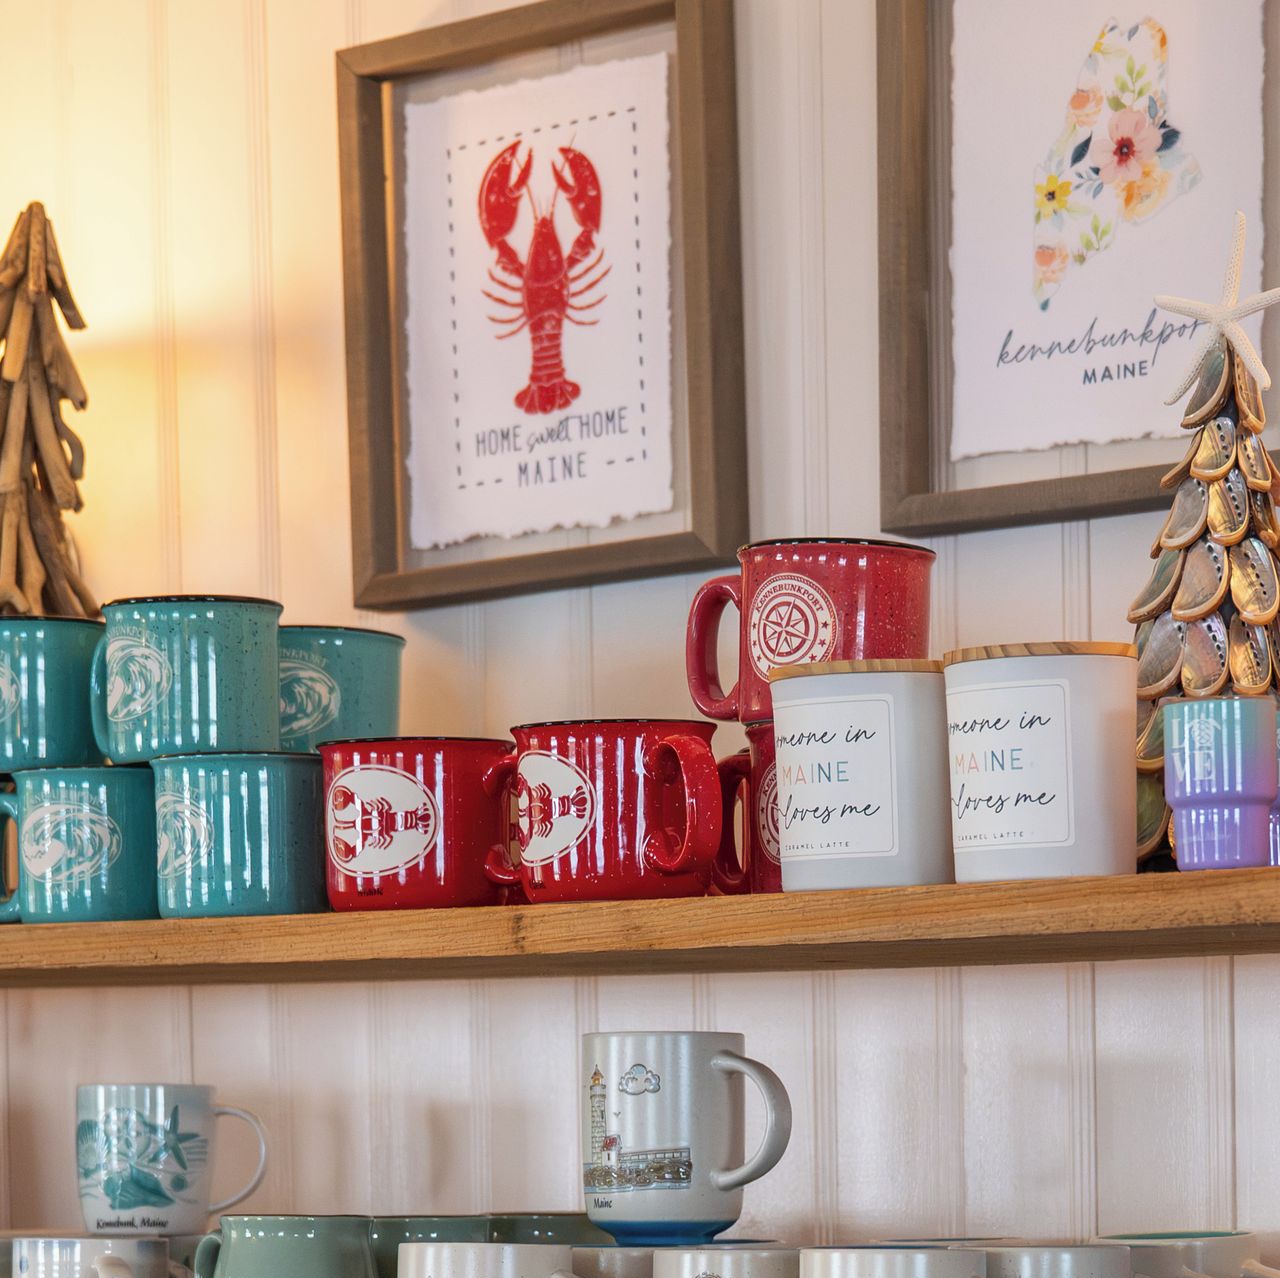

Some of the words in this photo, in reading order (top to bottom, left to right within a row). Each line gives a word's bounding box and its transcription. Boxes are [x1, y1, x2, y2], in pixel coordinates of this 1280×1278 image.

[996, 308, 1208, 367] kennebunkpor
[1082, 361, 1148, 385] MAINE
[475, 425, 522, 457] HOME
[579, 406, 628, 440] HOME
[518, 452, 587, 488] MAINE
[754, 583, 824, 613] KENNEBUNKPORT
[1020, 711, 1051, 729] in
[846, 725, 876, 743] in
[782, 761, 849, 786] MAINE
[955, 748, 1023, 774] MAINE
[779, 794, 837, 830] loves
[840, 803, 880, 818] me
[951, 783, 1010, 820] loves
[1014, 792, 1056, 807] me
[820, 841, 849, 849] LATTE
[993, 831, 1024, 839] LATTE
[593, 1196, 613, 1209] Maine
[141, 1216, 169, 1228] Maine
